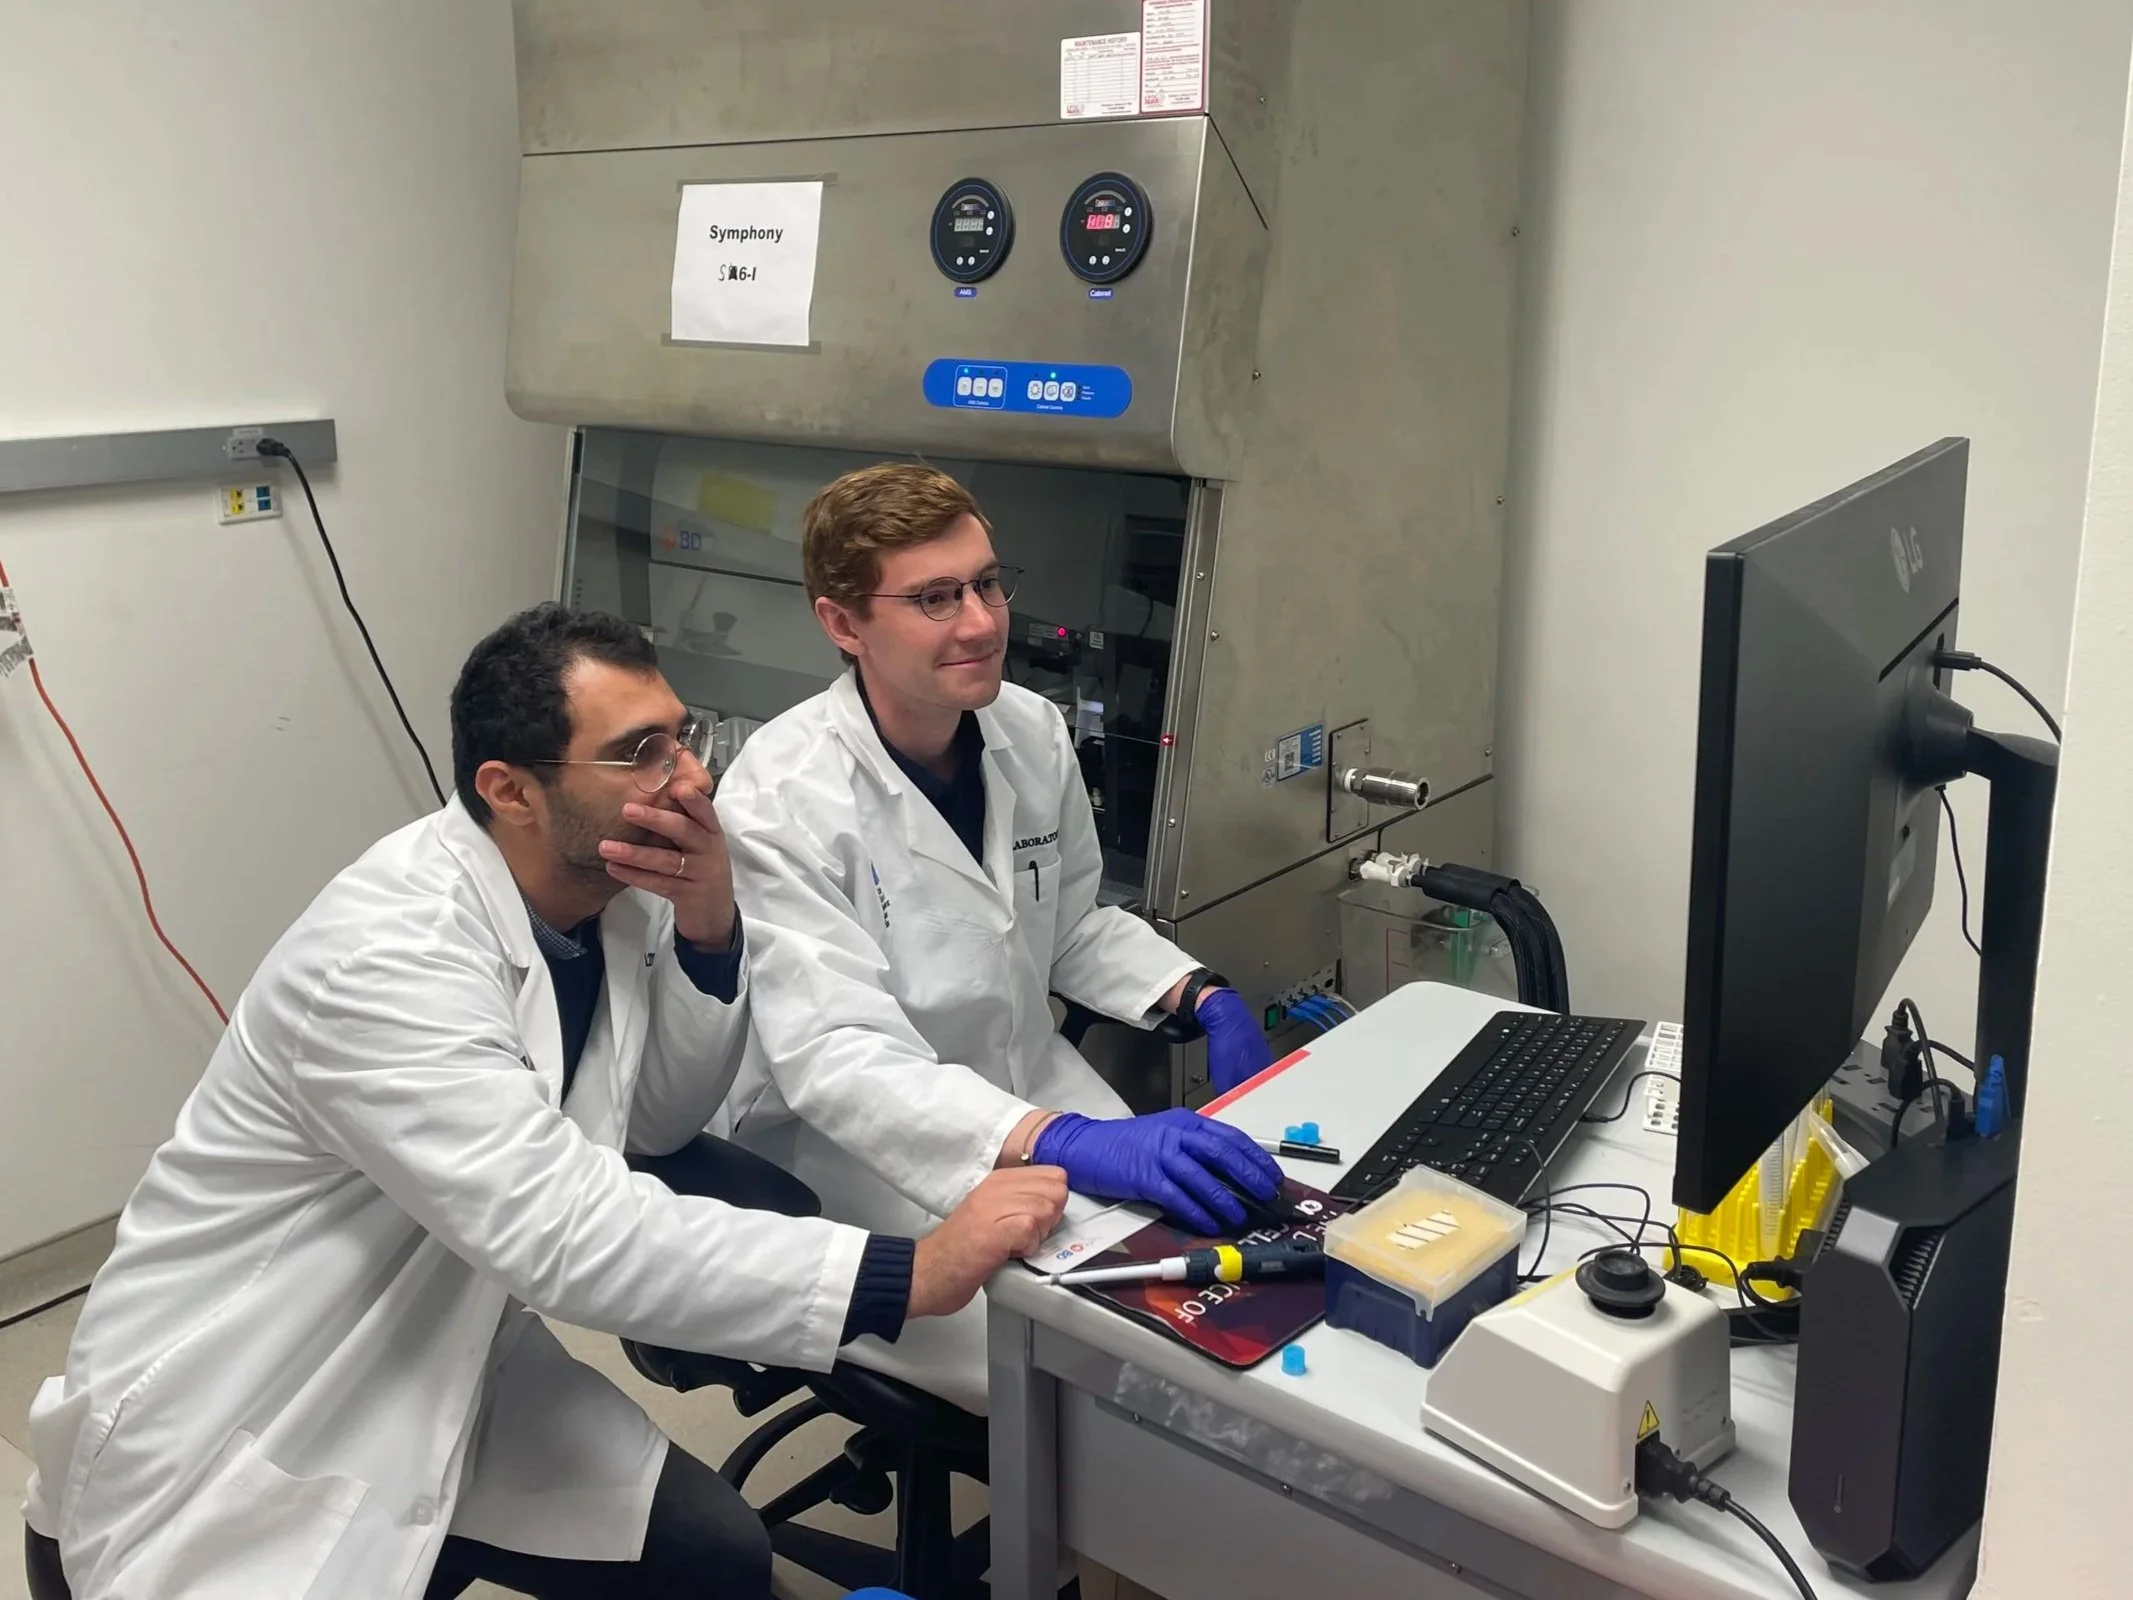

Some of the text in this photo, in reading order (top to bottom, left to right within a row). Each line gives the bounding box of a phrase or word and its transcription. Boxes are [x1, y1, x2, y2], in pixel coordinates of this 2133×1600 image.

[709, 225, 784, 243] Symphony
[680, 530, 702, 551] BD
[1903, 526, 1923, 574] LG
[1012, 829, 1059, 850] ABORATO
[1173, 1299, 1206, 1324] OF
